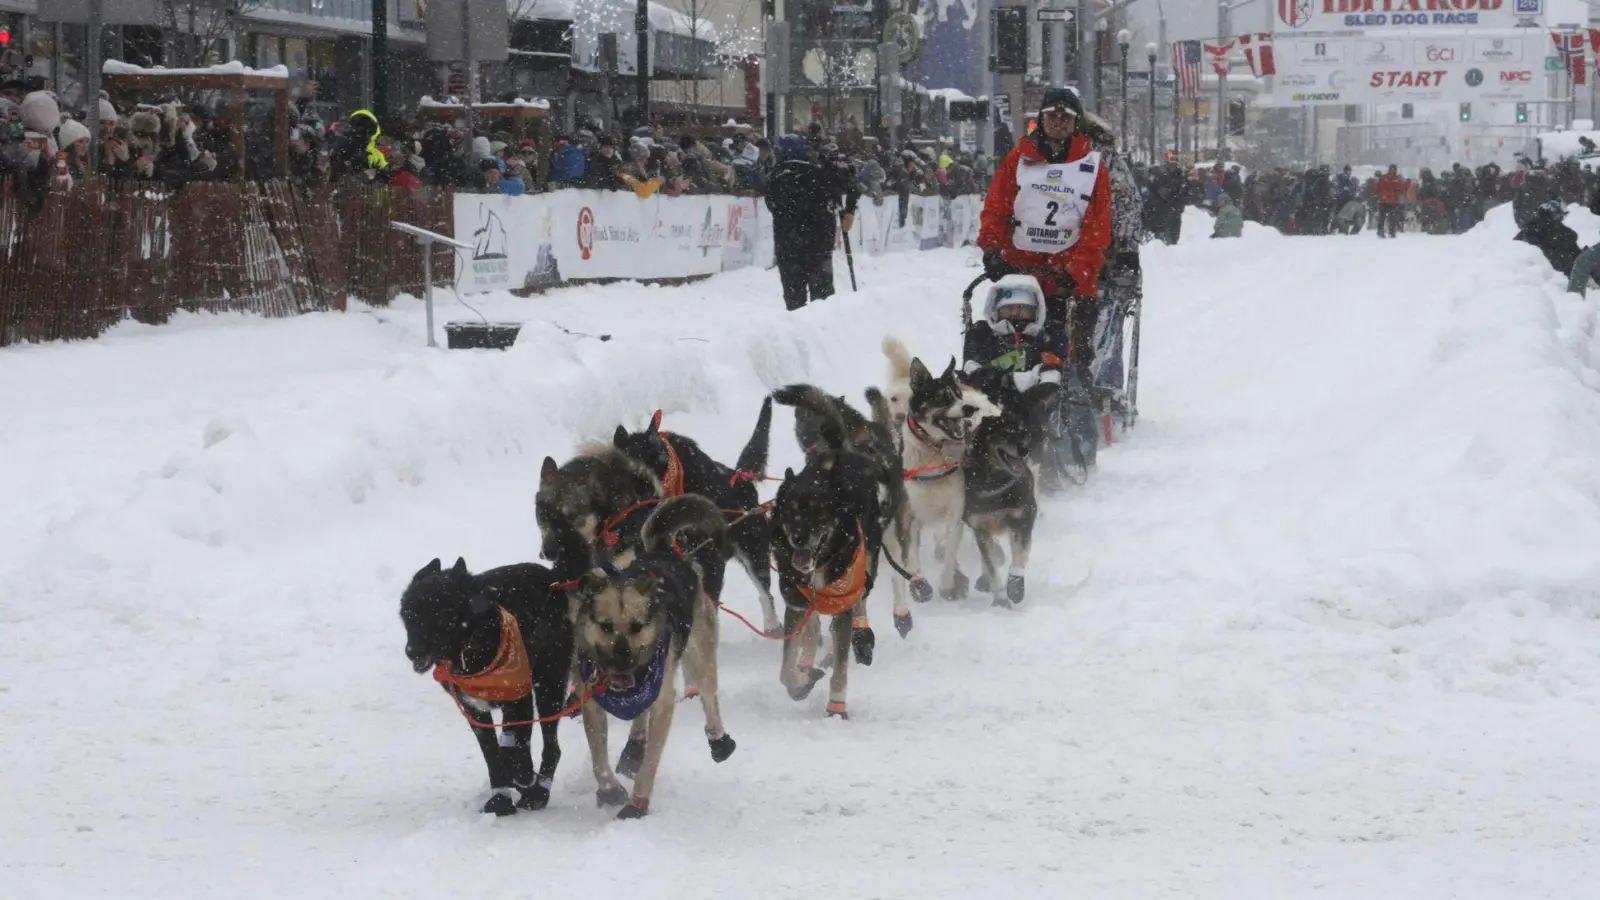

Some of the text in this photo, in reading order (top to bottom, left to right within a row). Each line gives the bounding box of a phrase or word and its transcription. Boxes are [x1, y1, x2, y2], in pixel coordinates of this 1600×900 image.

[1344, 12, 1479, 26] SLED DOG RACE
[1426, 48, 1455, 62] GCI
[1369, 70, 1448, 88] START
[1300, 92, 1340, 101] LYNDEN
[1031, 183, 1075, 195] DONLIN
[1045, 201, 1059, 226] 2
